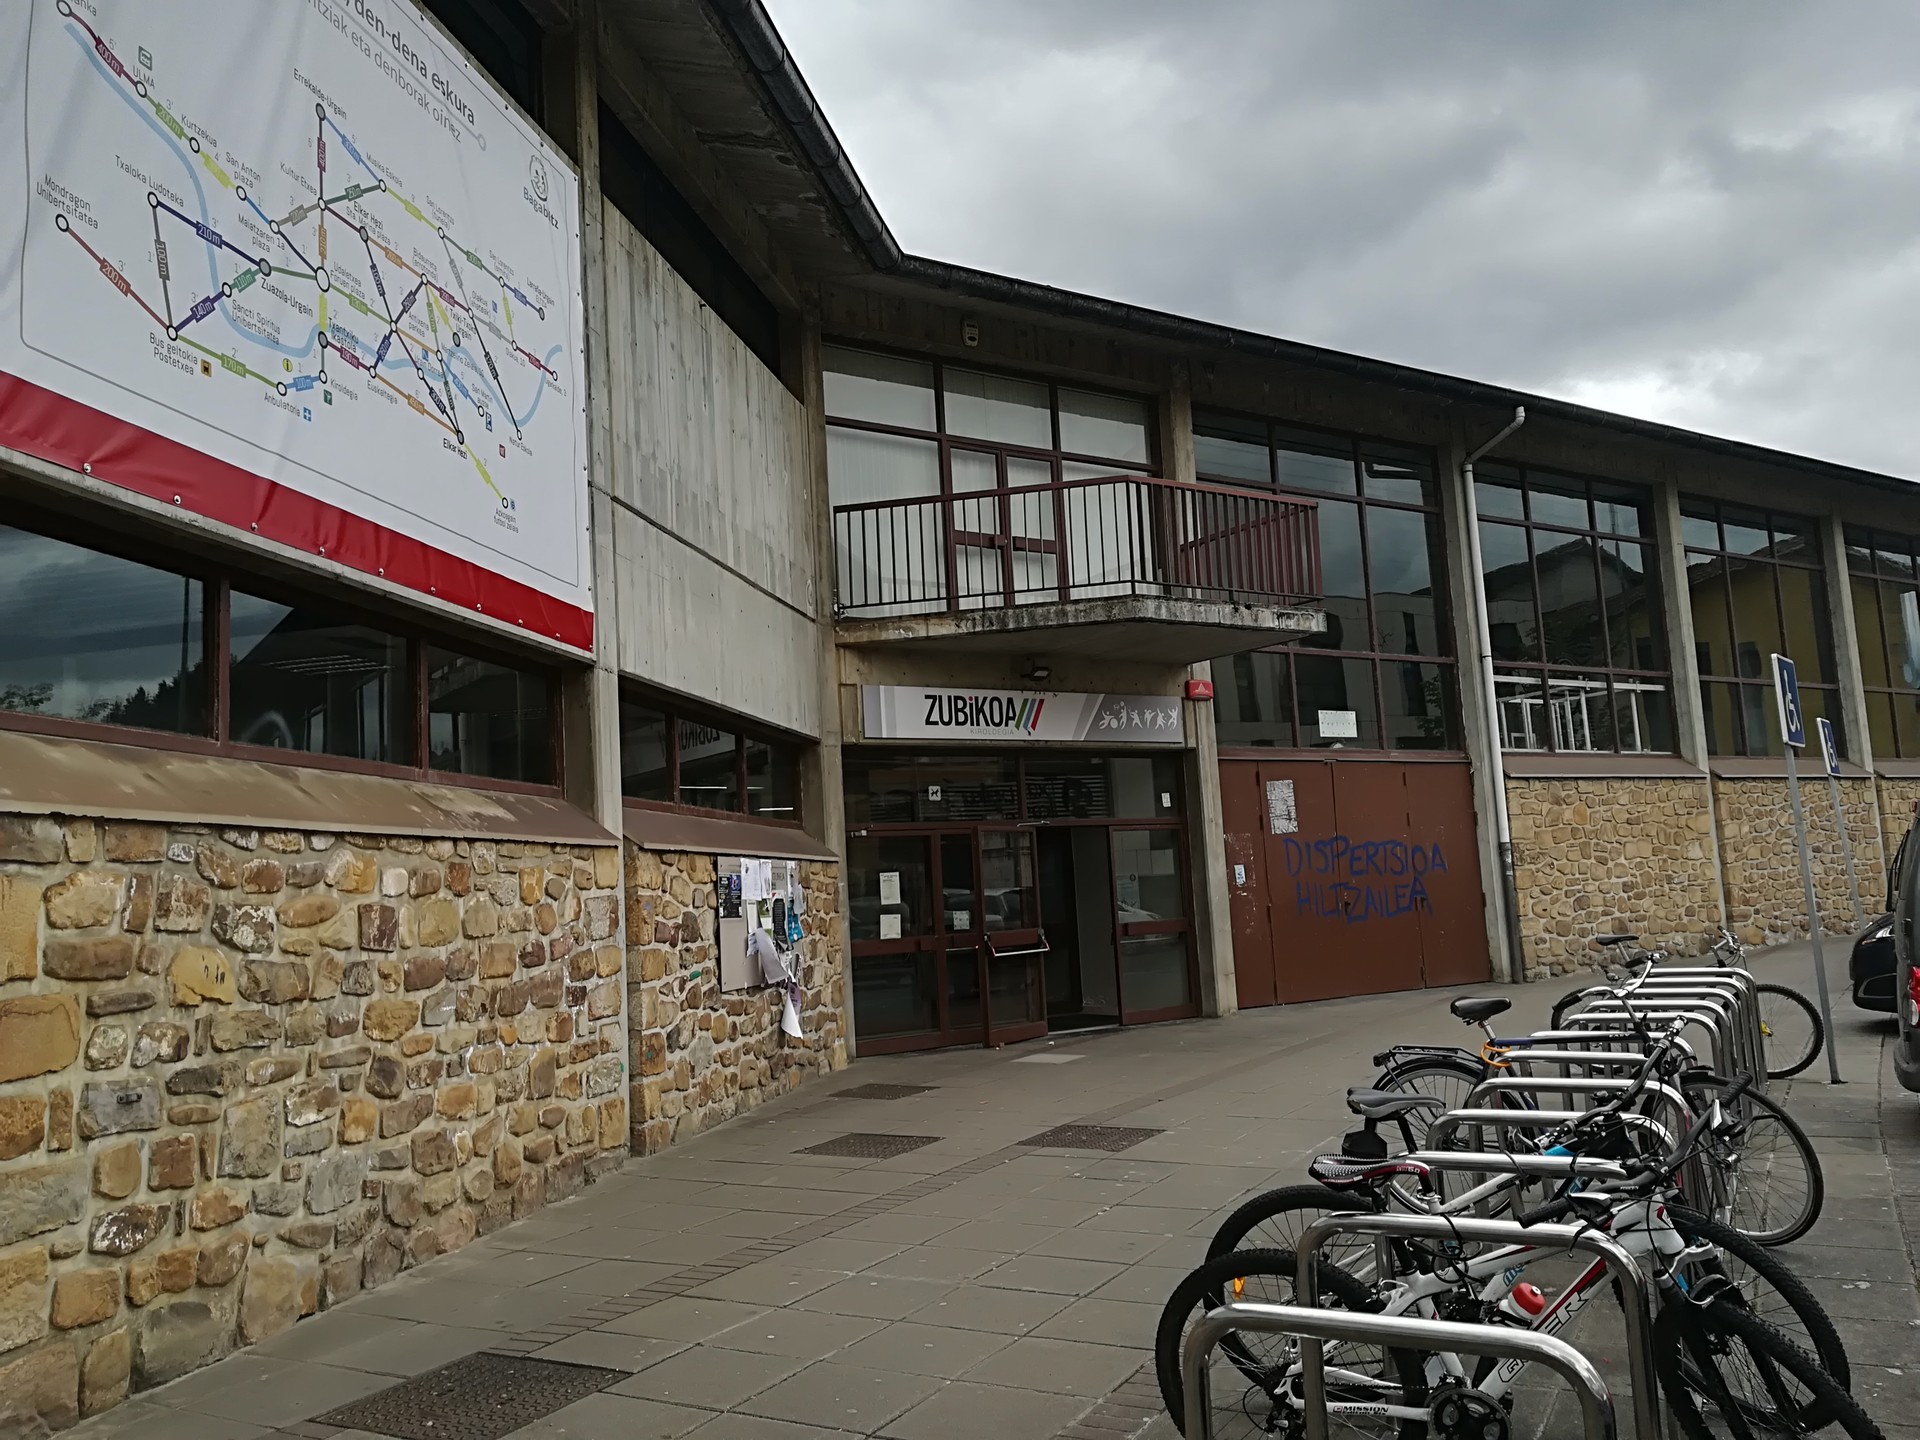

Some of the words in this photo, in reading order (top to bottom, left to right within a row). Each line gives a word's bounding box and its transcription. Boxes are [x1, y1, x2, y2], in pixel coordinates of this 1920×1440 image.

[132, 65, 156, 90] ULMA
[293, 68, 348, 121] Errekalde-Urgain
[351, 31, 372, 58] eta
[374, 51, 430, 115] denborak
[432, 108, 462, 143] oinez
[431, 73, 475, 126] eskura
[181, 114, 218, 148] Kurtzekua
[115, 155, 147, 184] Txaloka
[148, 176, 185, 207] Ludoteka
[225, 152, 240, 169] San
[241, 163, 261, 183] Anton
[233, 170, 254, 189] plaza
[36, 182, 99, 230] Unibertsitatea
[44, 174, 91, 213] Mondragon
[232, 299, 256, 319] Sancti
[256, 313, 281, 336] Spiritus
[260, 277, 314, 318] Zuazola-Urgain
[149, 332, 165, 350] Bus
[166, 342, 198, 366] geltokia
[153, 346, 194, 376] Postetxea
[1283, 834, 1448, 878] DISPERTSIOA
[1295, 874, 1434, 925] HILTZAILEA
